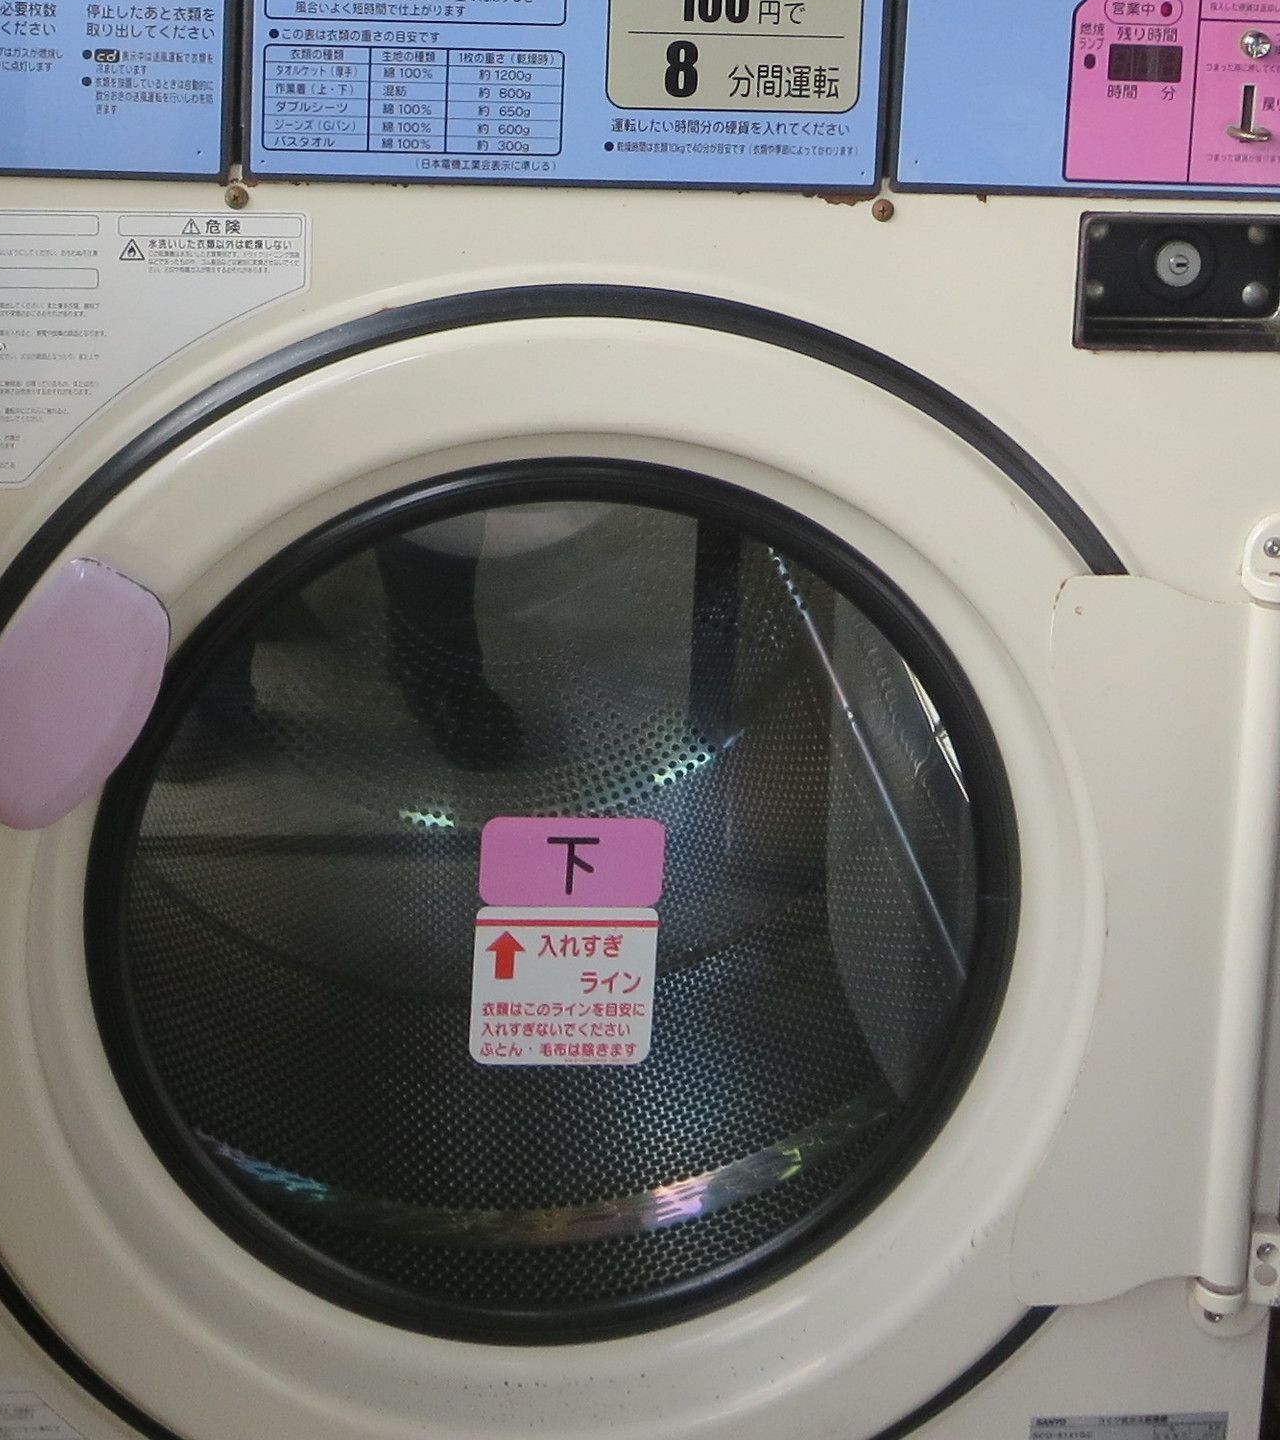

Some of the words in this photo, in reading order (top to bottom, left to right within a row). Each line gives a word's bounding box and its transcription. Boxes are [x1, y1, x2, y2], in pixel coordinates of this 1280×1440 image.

[87, 3, 215, 22] 停止したあと衣類を
[295, 2, 465, 17] 風合いよく短時間で仕上がります
[758, 0, 806, 25] 円で
[1112, 2, 1155, 16] 営業中
[86, 22, 215, 40] 取り出してください
[281, 29, 440, 43] この表は衣類の重さの目安です
[1117, 27, 1178, 43] 残り時間
[290, 48, 344, 61] 衣類の種類
[382, 51, 436, 63] 生地の種類
[665, 40, 698, 98] 8
[728, 64, 840, 99] 分間運転
[1107, 85, 1138, 100] 時間
[1161, 86, 1176, 101] 分
[276, 101, 348, 113] ダブルシーツ
[611, 118, 850, 136] 運転したい時間分の硬貨を入れてください
[274, 136, 335, 148] バスタオル
[205, 219, 241, 235] 危険
[547, 837, 599, 895] 下
[538, 935, 624, 958] 入れすぎ
[581, 971, 642, 994] ライン
[482, 1003, 645, 1017] 衣類はこのラインを目安に
[481, 1023, 631, 1037] 入れすぎないでください
